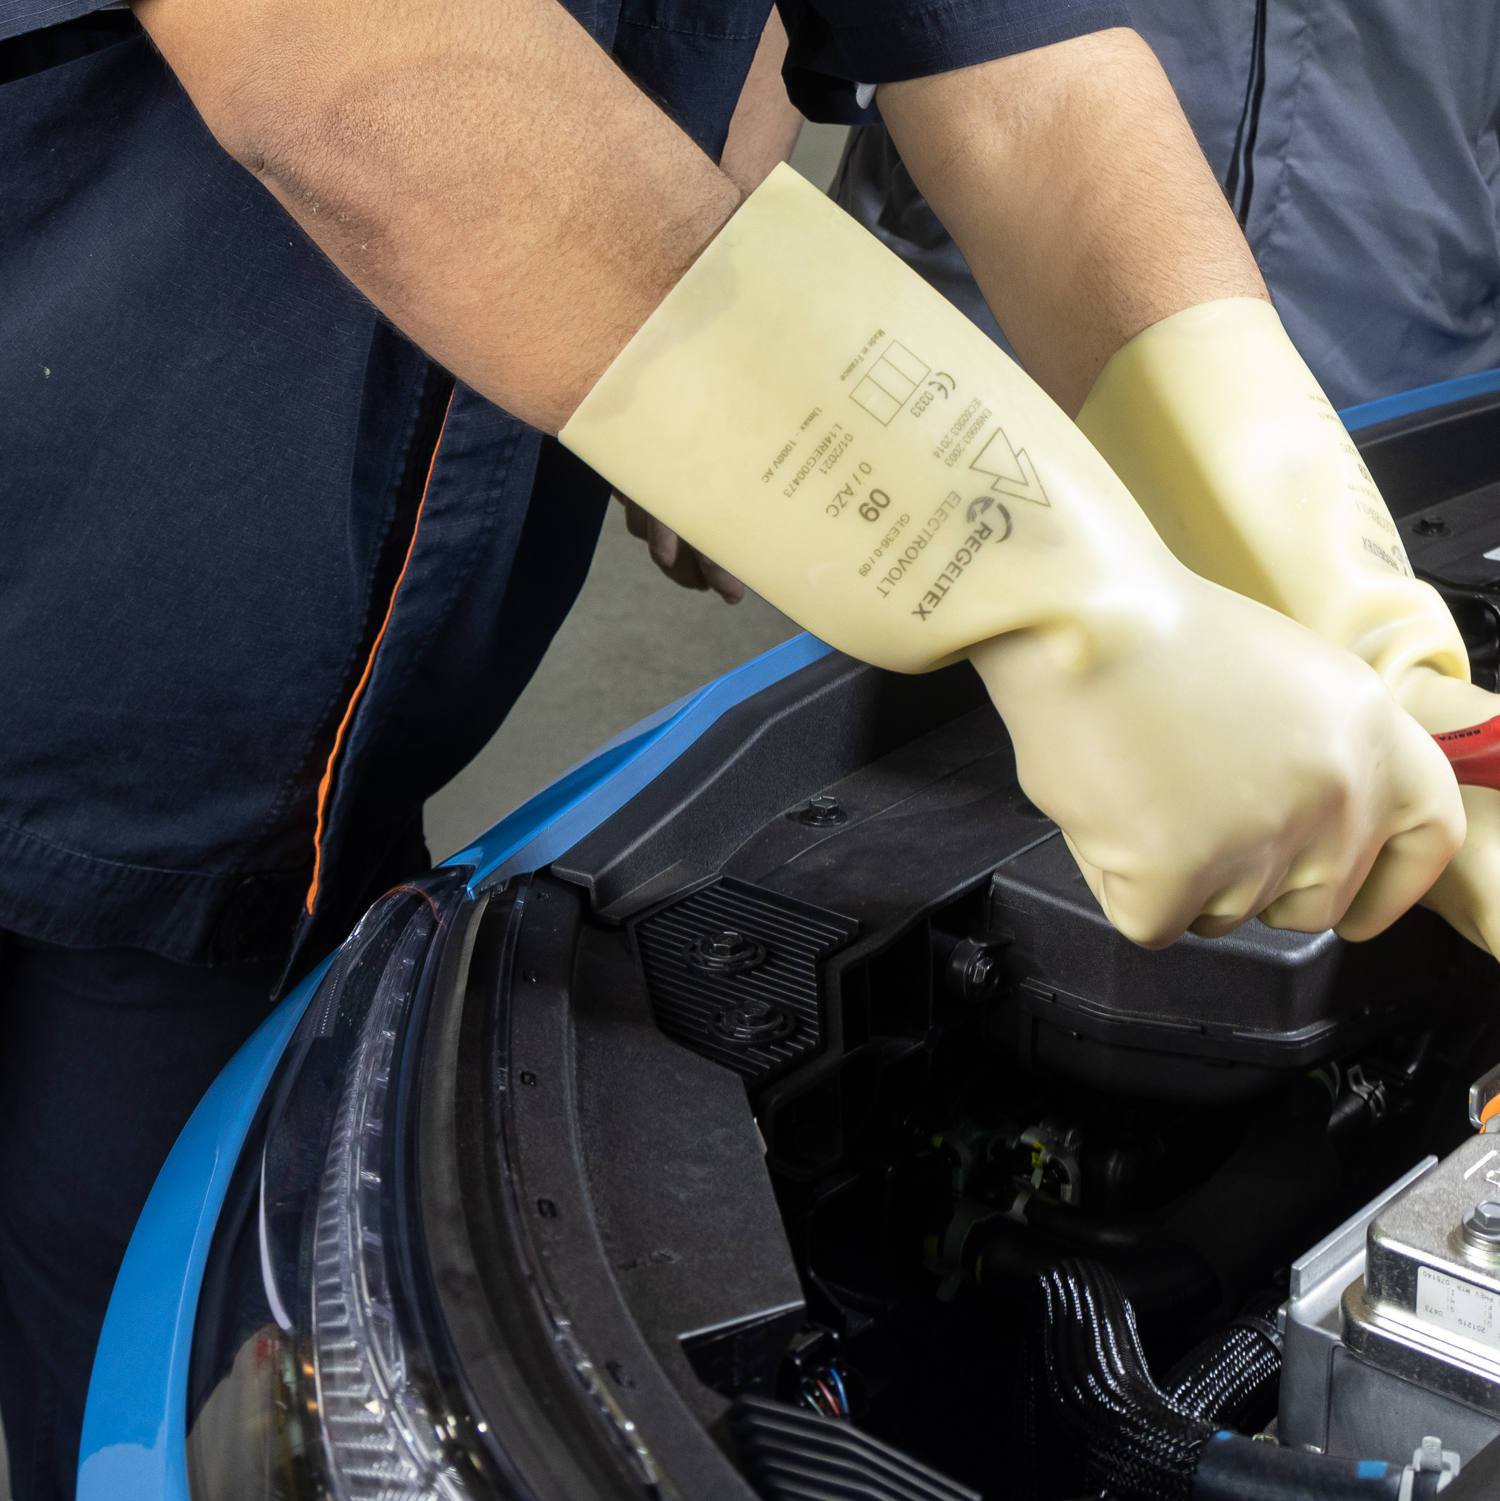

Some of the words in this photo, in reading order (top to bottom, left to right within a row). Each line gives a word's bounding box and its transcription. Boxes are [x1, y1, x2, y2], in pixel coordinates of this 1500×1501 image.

[867, 328, 886, 347] Made
[839, 354, 864, 382] France
[799, 407, 823, 431] Umax
[909, 390, 935, 419] 0333
[772, 440, 797, 470] 1000V
[783, 423, 843, 498] L14REG00473
[818, 432, 854, 476] 01/2021
[761, 467, 775, 483] AC
[825, 482, 855, 518] AZC
[858, 488, 891, 523] 09
[873, 513, 911, 558] GLE36-0
[876, 490, 962, 599] ELECTROVOLT
[858, 562, 872, 577] 09
[911, 521, 994, 622] REGELTEX
